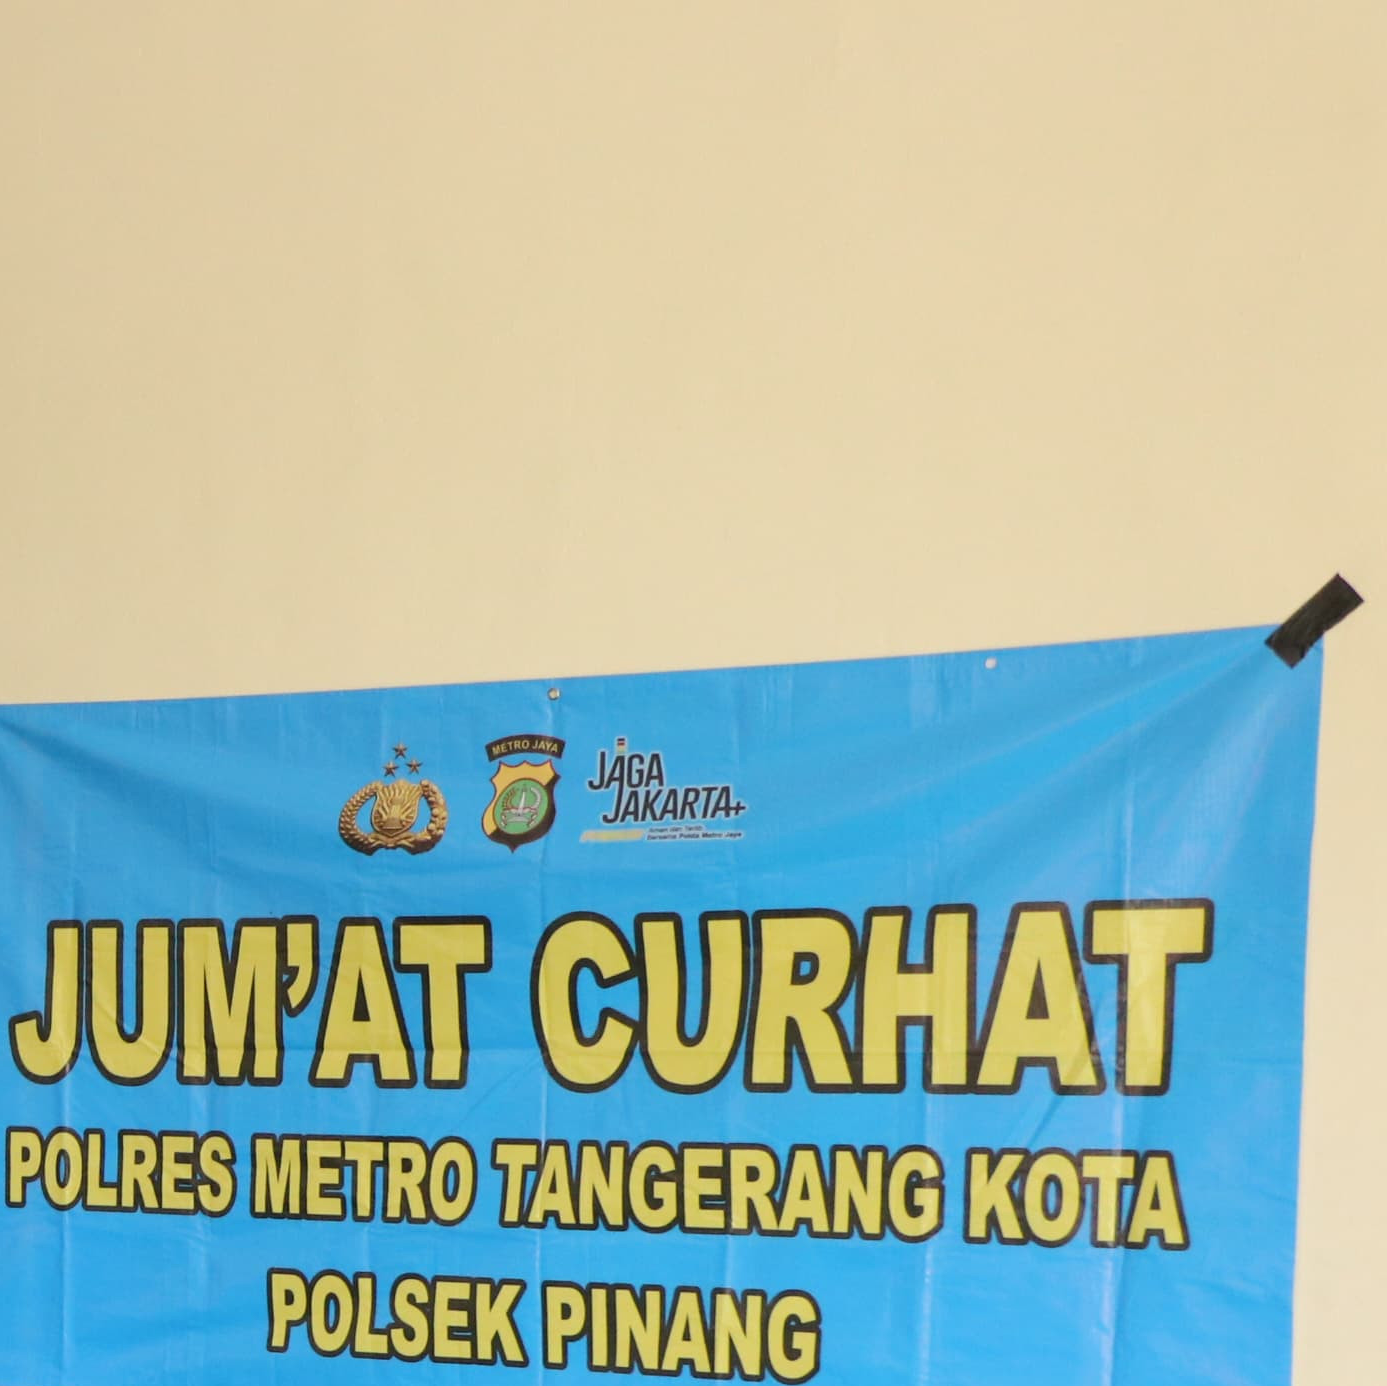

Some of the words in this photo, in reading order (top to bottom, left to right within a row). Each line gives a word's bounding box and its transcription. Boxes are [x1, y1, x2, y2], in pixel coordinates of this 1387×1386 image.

[492, 740, 529, 755] METRO
[532, 740, 558, 753] JAYA
[588, 750, 664, 790] JAGA
[9, 915, 492, 1090] JUM'AT
[531, 900, 1213, 1095] CURHAT
[6, 1127, 237, 1217] POLRES
[251, 1134, 477, 1226] METRO
[491, 1139, 944, 1242] TANGERANG
[965, 1148, 1188, 1250] KOTA
[267, 1268, 528, 1367] POLSEK
[542, 1281, 820, 1384] PINANG
